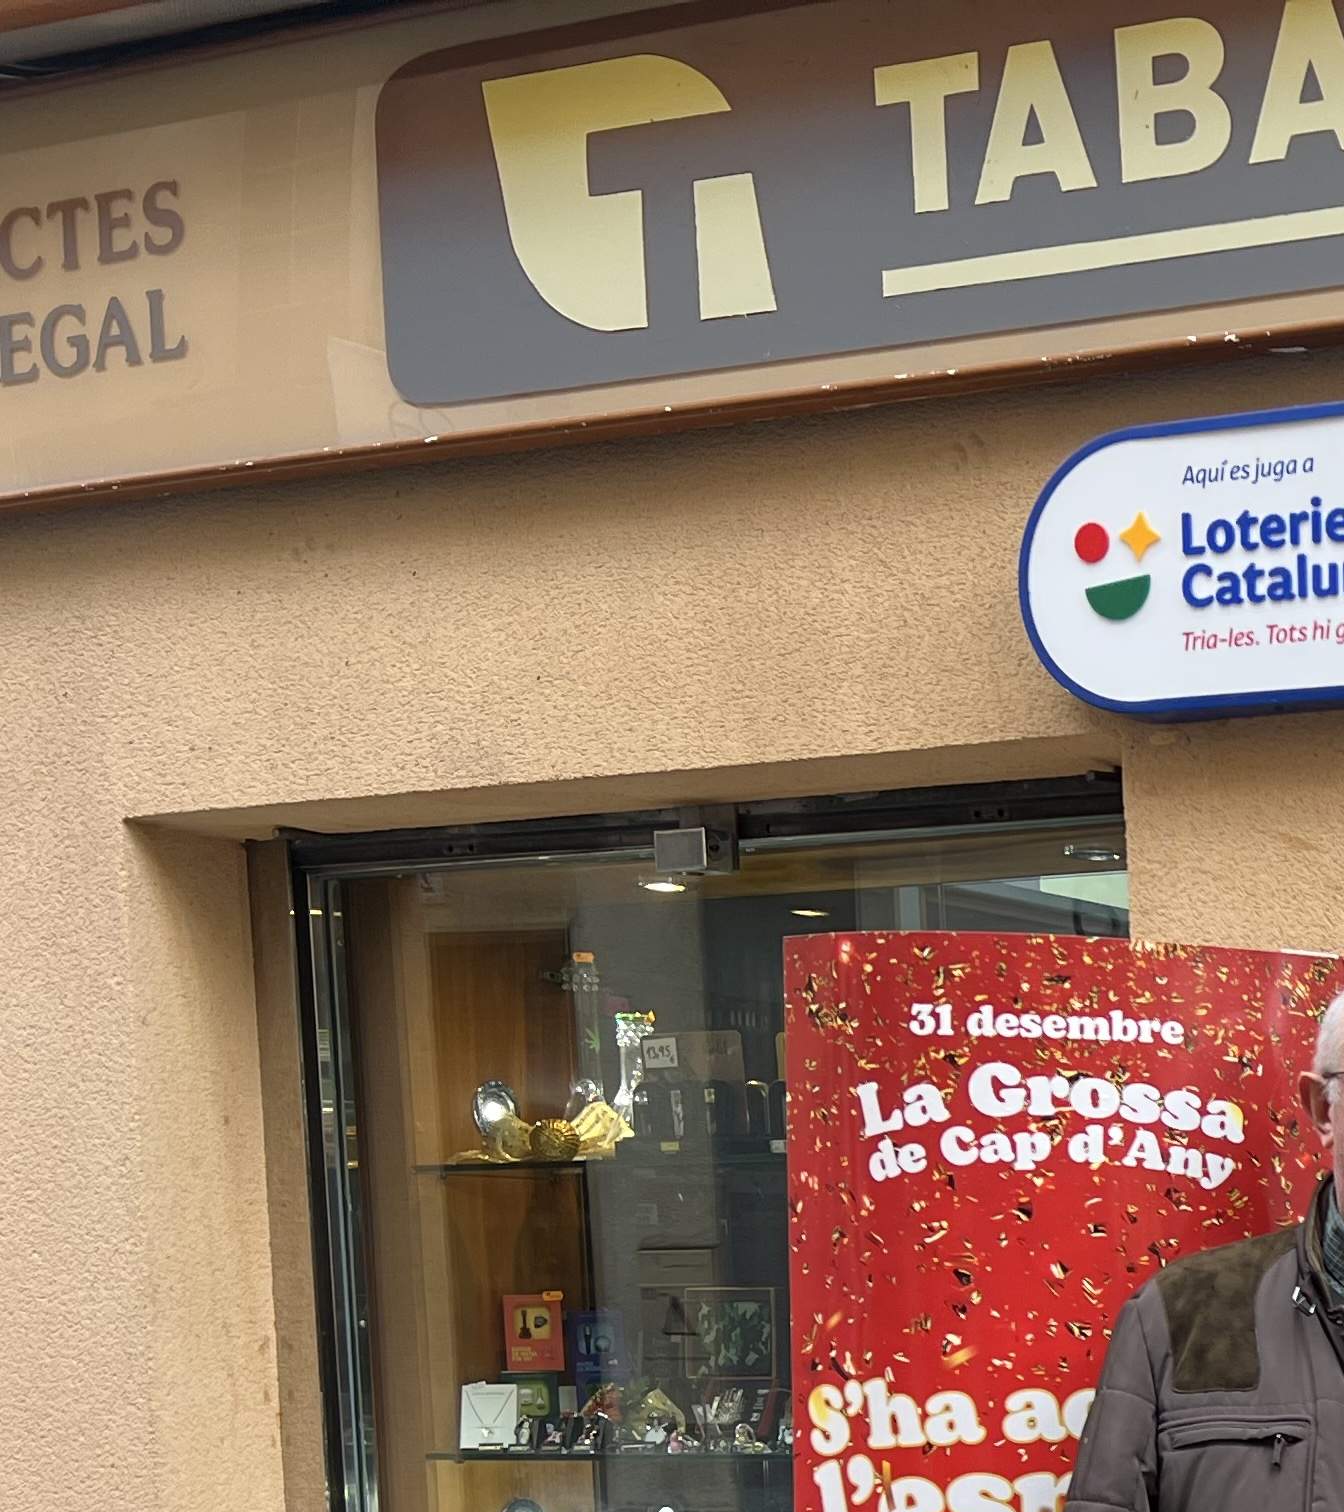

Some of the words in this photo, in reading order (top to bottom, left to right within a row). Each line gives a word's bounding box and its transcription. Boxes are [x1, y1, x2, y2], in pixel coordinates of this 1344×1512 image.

[0, 289, 188, 388] EGAL
[1181, 459, 1229, 487] Aquí
[1230, 463, 1250, 481] es
[1252, 457, 1297, 484] juga
[1302, 456, 1315, 474] a
[1182, 628, 1261, 652] Tria-les.
[1266, 624, 1309, 646] Tots
[1312, 621, 1332, 641] hi
[908, 1003, 953, 1037] 31
[966, 1005, 1185, 1046] desembre
[855, 1079, 951, 1138] La
[967, 1061, 1247, 1145] Grossa
[867, 1138, 927, 1183] de
[940, 1126, 1051, 1170] Cap
